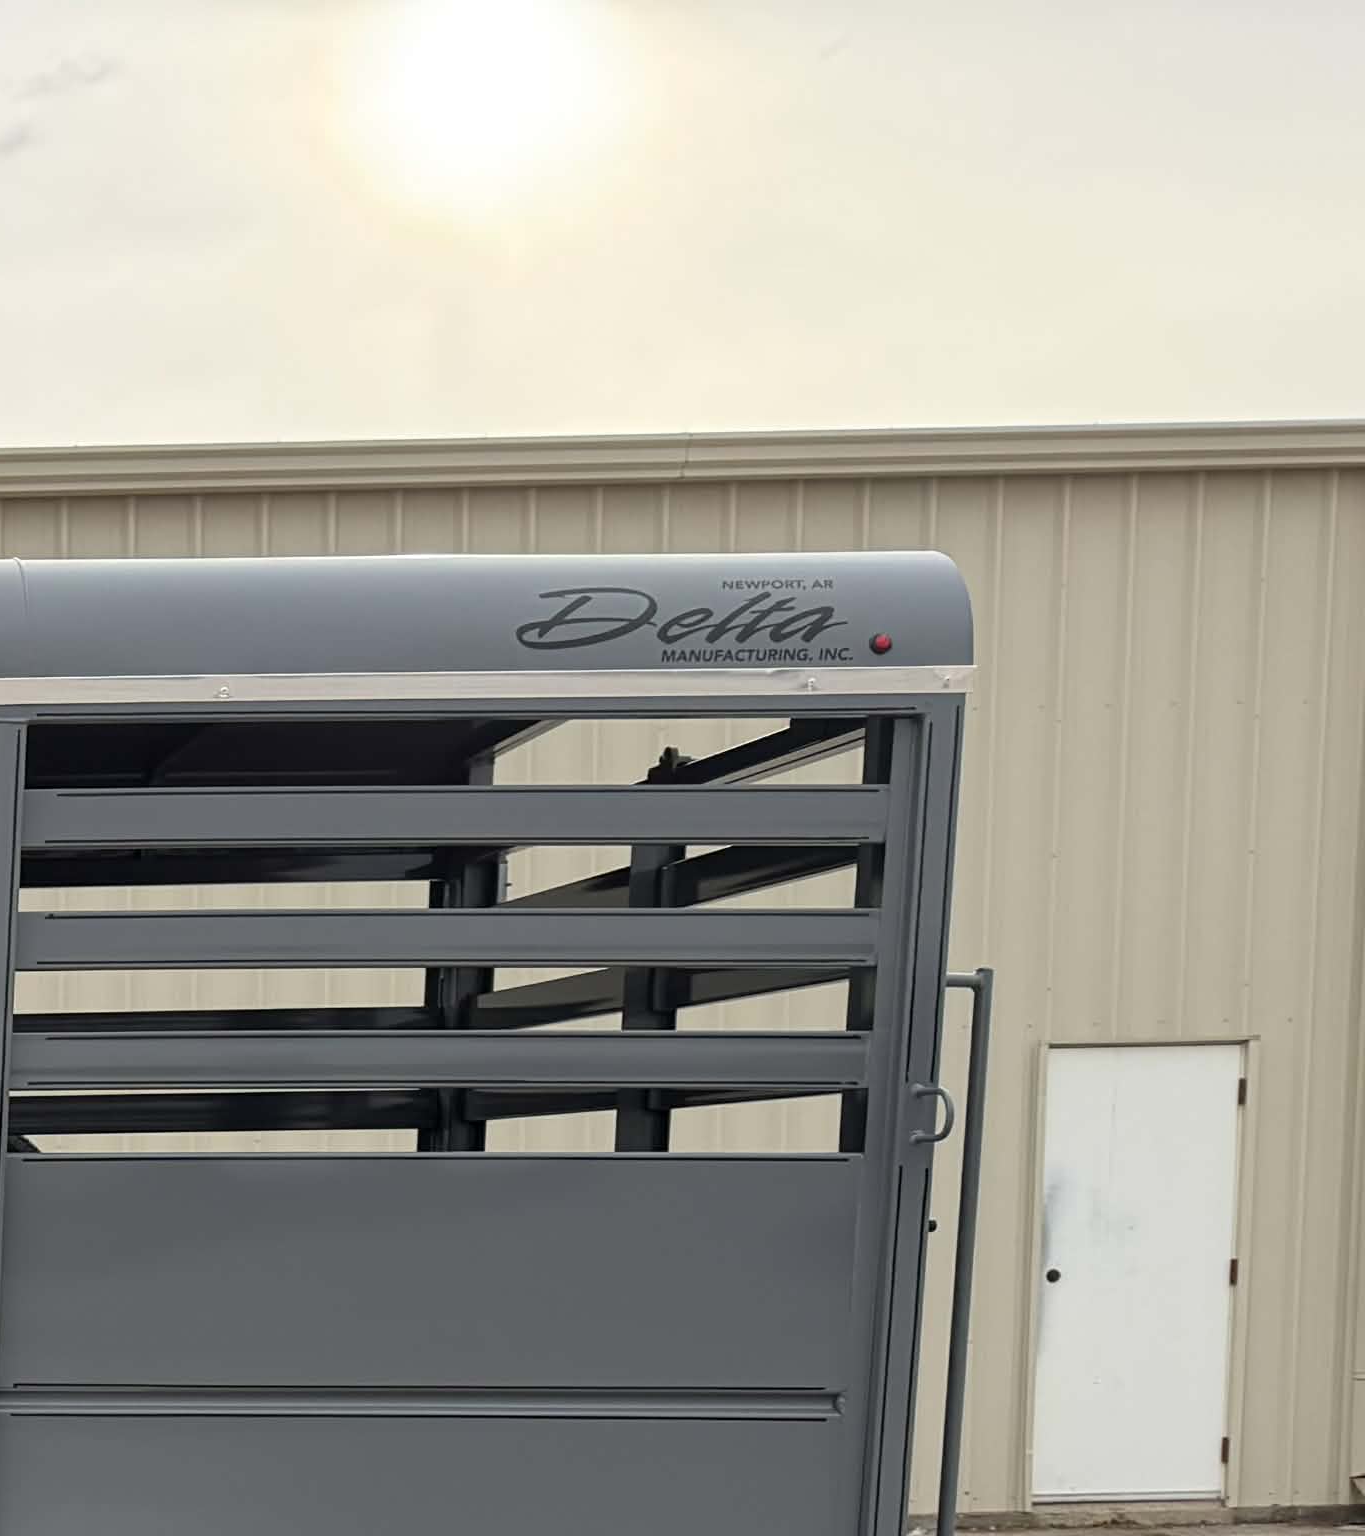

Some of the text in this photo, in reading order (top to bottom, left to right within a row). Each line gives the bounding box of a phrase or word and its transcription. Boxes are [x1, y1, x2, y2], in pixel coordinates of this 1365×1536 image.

[722, 579, 834, 591] NEWPORT, AR
[516, 586, 849, 650] Delta
[818, 647, 854, 661] INC.
